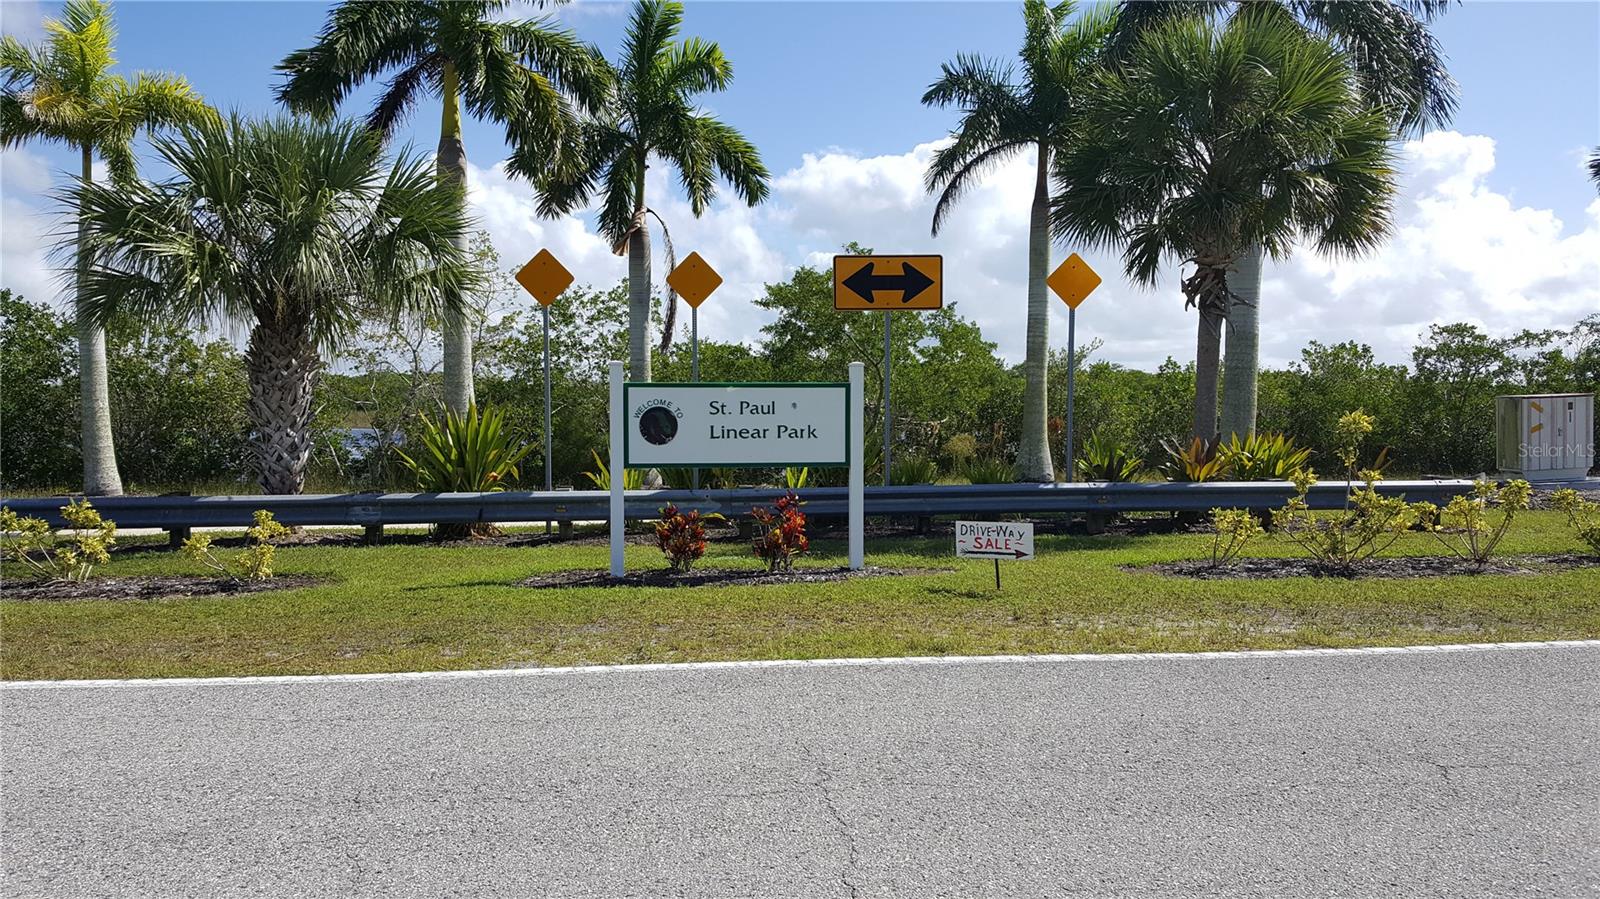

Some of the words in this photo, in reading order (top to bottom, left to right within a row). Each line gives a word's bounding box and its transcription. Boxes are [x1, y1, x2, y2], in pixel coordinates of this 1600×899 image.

[633, 399, 673, 419] WELCOME
[674, 407, 684, 419] TO
[709, 401, 732, 415] St.
[740, 401, 776, 415] Paul
[709, 425, 769, 440] Linear
[777, 425, 818, 440] Park
[973, 537, 1012, 550] SALE
